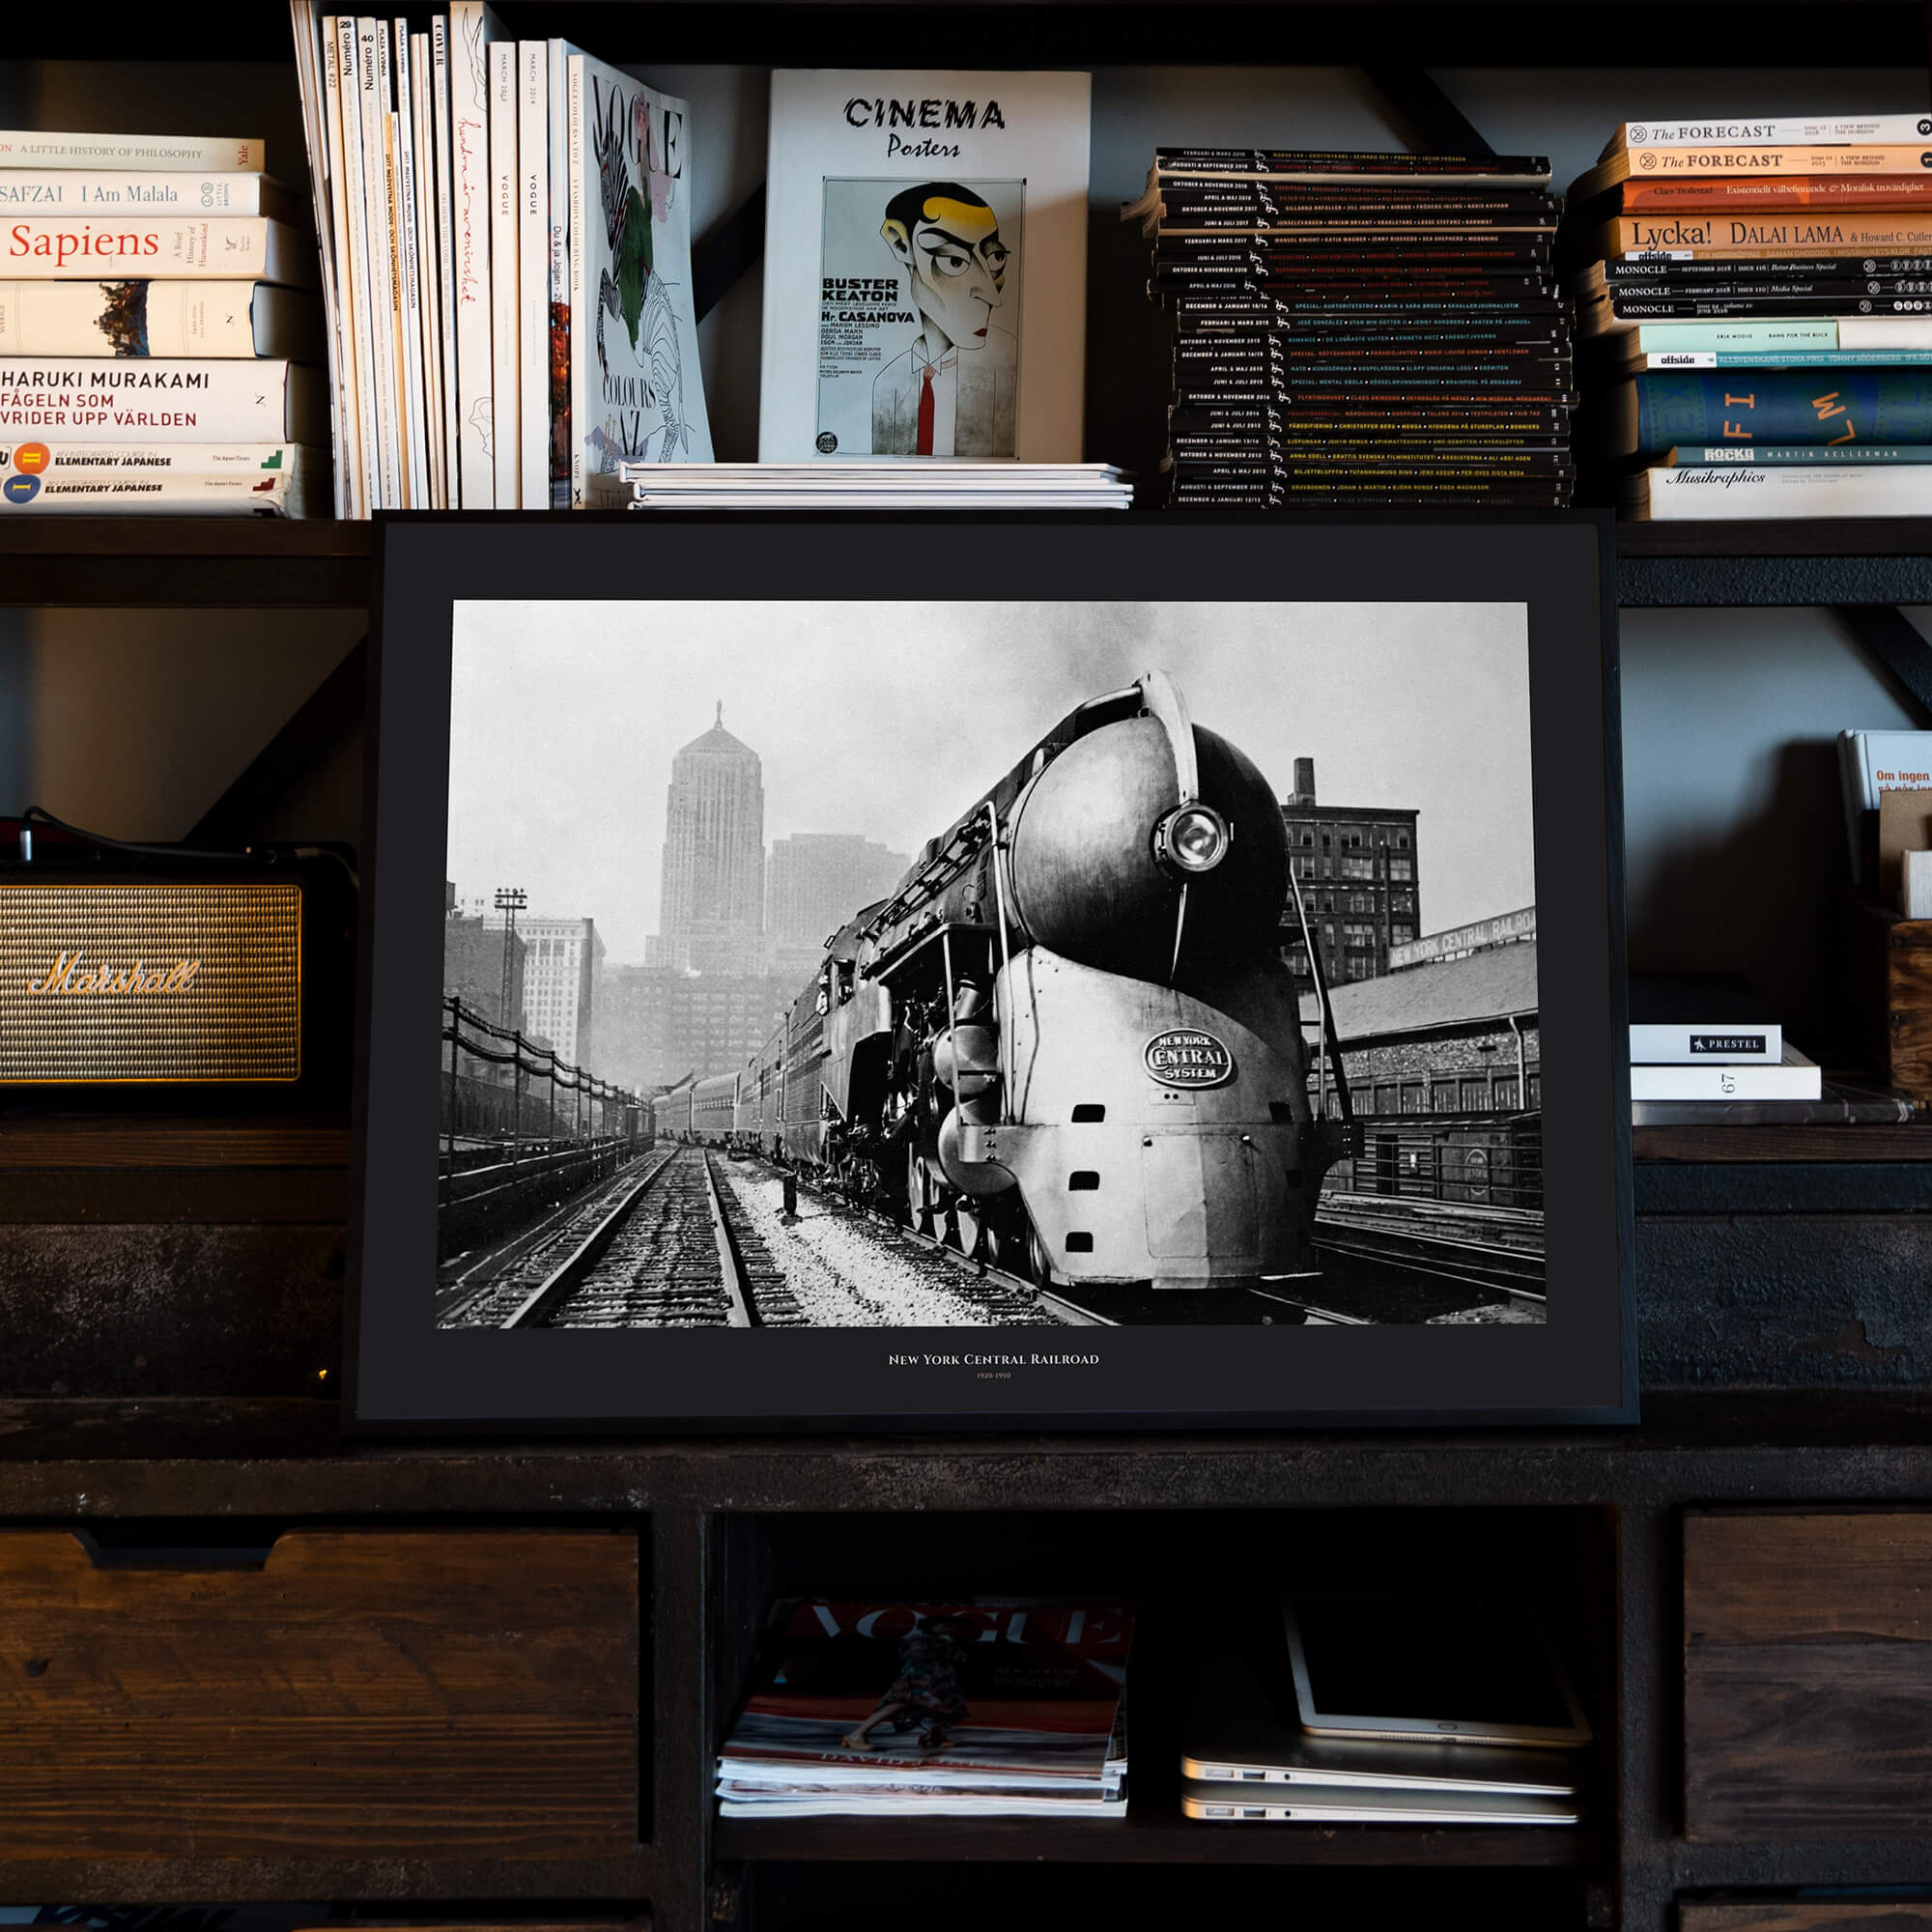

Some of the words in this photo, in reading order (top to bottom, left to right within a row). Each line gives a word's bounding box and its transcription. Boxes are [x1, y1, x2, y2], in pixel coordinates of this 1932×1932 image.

[361, 34, 374, 43] 40
[435, 24, 444, 67] COVER
[327, 41, 335, 71] METAL
[343, 32, 353, 76] Numéro
[364, 46, 374, 91] Numéro
[844, 97, 1006, 129] CINEMA
[592, 74, 683, 180] VOGUE
[1652, 128, 1675, 141] The
[1678, 125, 1776, 140] FORECAST
[19, 145, 28, 154] A
[30, 145, 68, 155] LITTLE
[70, 146, 115, 156] HISTORY
[118, 147, 133, 157] OF
[135, 148, 203, 159] PHILOSOPHY
[887, 132, 961, 158] Posters
[238, 145, 249, 166] Yale
[1662, 156, 1685, 169] The
[1688, 155, 1784, 168] FORECAST
[0, 185, 64, 203] SAFZAI
[82, 185, 87, 202] I
[94, 185, 121, 202] Am
[127, 185, 179, 203] Malala
[1726, 185, 1771, 194] Existentiellt
[1840, 183, 1874, 192] Moralisk
[174, 232, 183, 250] Brief
[1633, 220, 1712, 250] Lycka!
[1730, 221, 1787, 243] DALAI
[1795, 225, 1844, 243] LAMA
[1850, 233, 1858, 242] &
[1861, 232, 1893, 242] Howard
[1907, 231, 1932, 242] Cutler
[10, 225, 158, 268] Sapiens
[185, 236, 197, 264] History
[198, 223, 209, 268] Humankind
[1615, 265, 1667, 275] MONOCLE
[1816, 262, 1837, 271] Special
[822, 278, 899, 290] BUSTER
[1619, 287, 1671, 297] MONOCLE
[1791, 284, 1813, 294] Special
[822, 290, 898, 301] KEATON
[821, 311, 837, 322] Hr.
[838, 311, 915, 323] CASANOVA
[1623, 304, 1674, 314] MONOCLE
[1661, 355, 1695, 364] offside
[1, 371, 83, 387] HARUKI
[90, 372, 210, 388] MURAKAMI
[1, 388, 71, 408] FÅGELN
[76, 393, 115, 408] SOM
[602, 375, 657, 410] COLOURS
[1, 411, 67, 426] VRIDER
[72, 412, 108, 426] UPP
[114, 410, 197, 427] VÄRLDEN
[55, 457, 119, 467] ELEMENTARY
[121, 457, 172, 467] JAPANESE
[1666, 469, 1766, 489] Musikraphics
[44, 484, 109, 495] ELEMENTARY
[111, 483, 163, 494] JAPANESE
[1876, 770, 1895, 781] Om
[1898, 770, 1930, 783] ingen
[1412, 938, 1439, 959] YORK
[1441, 924, 1489, 952] CENTRAL
[27, 950, 203, 996] Marshall
[1159, 1036, 1182, 1046] NEW
[1182, 1036, 1212, 1046] YORK
[1709, 1038, 1760, 1049] PRESTEL
[1147, 1046, 1229, 1070] CENTRAL
[1165, 1067, 1217, 1079] SYSTEM
[888, 1353, 919, 1366] NEW
[923, 1353, 961, 1366] YORK
[964, 1353, 1027, 1366] CENTRAL
[1031, 1353, 1100, 1366] RAILROAD
[811, 1605, 1123, 1645] VOGUE
